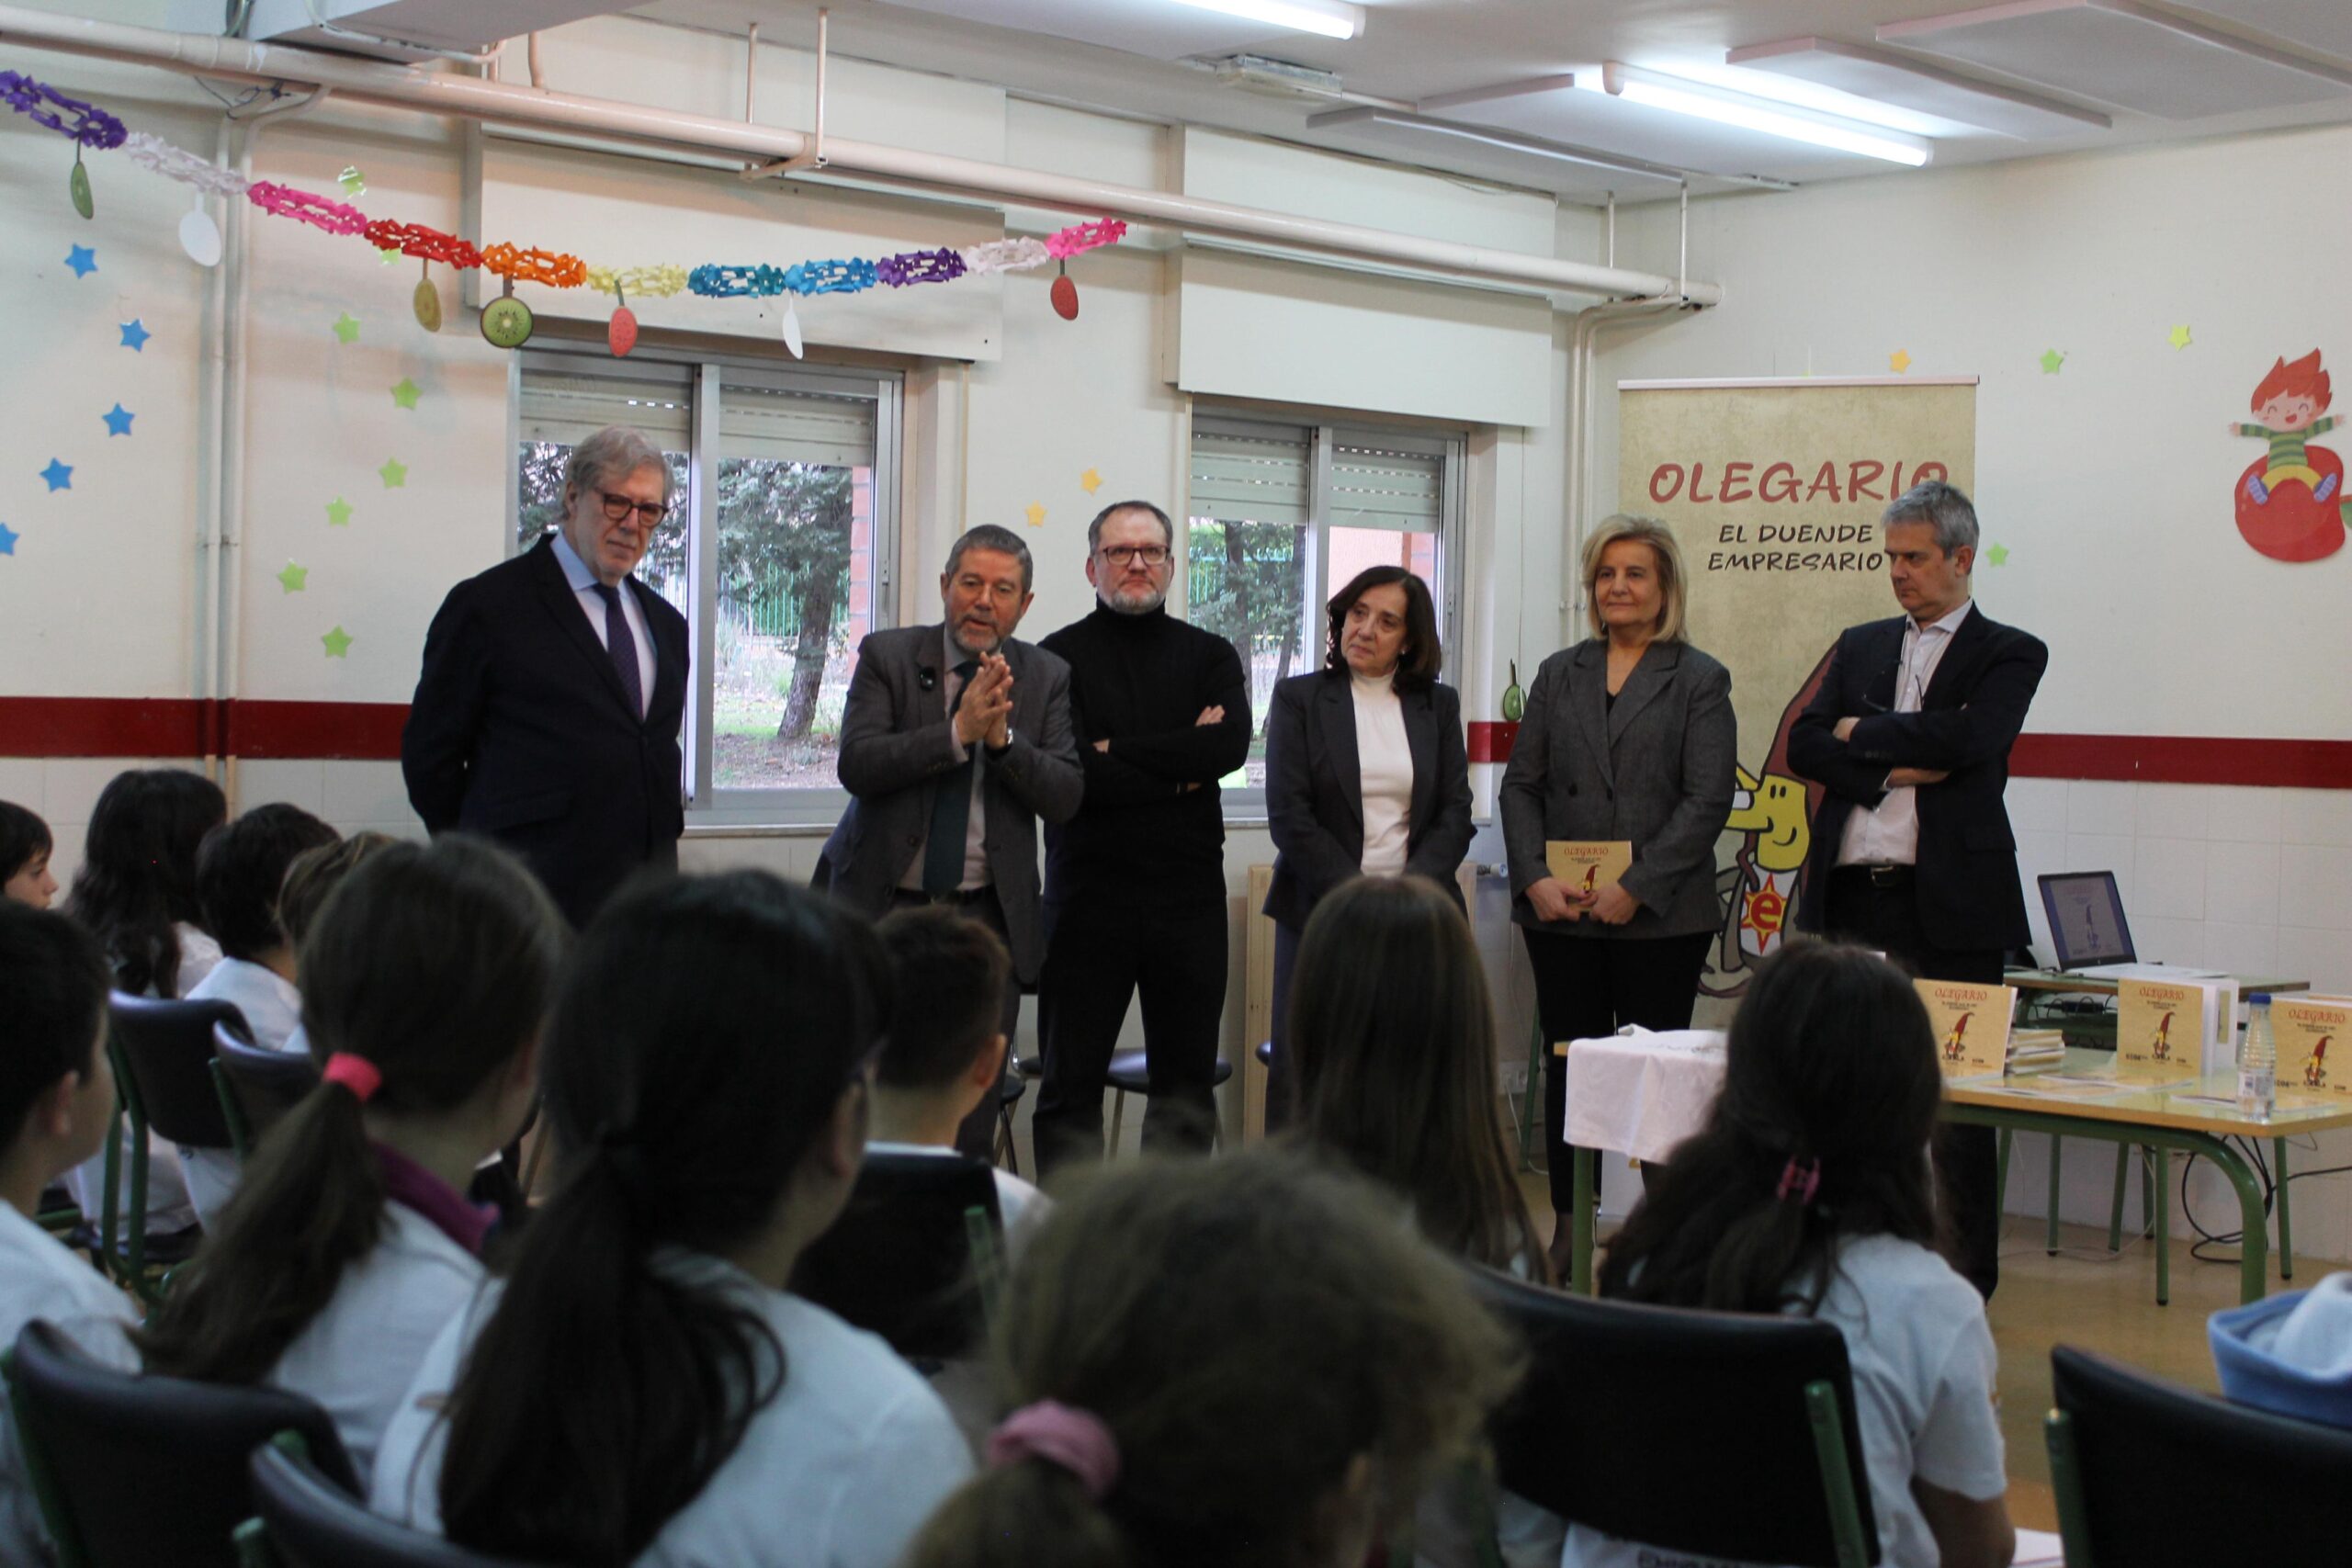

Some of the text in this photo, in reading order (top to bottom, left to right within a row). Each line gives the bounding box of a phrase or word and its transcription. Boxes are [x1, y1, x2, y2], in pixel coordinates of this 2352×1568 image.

[1720, 525, 1872, 543] EL DUENDE
[1708, 552, 1883, 571] EMPRESARIO
[1564, 847, 1609, 856] OLEGARIO
[1935, 987, 1987, 1000] OLEGARIO
[2139, 987, 2185, 1000] OLEGARIO
[2289, 1009, 2346, 1024] OLEGARIO
